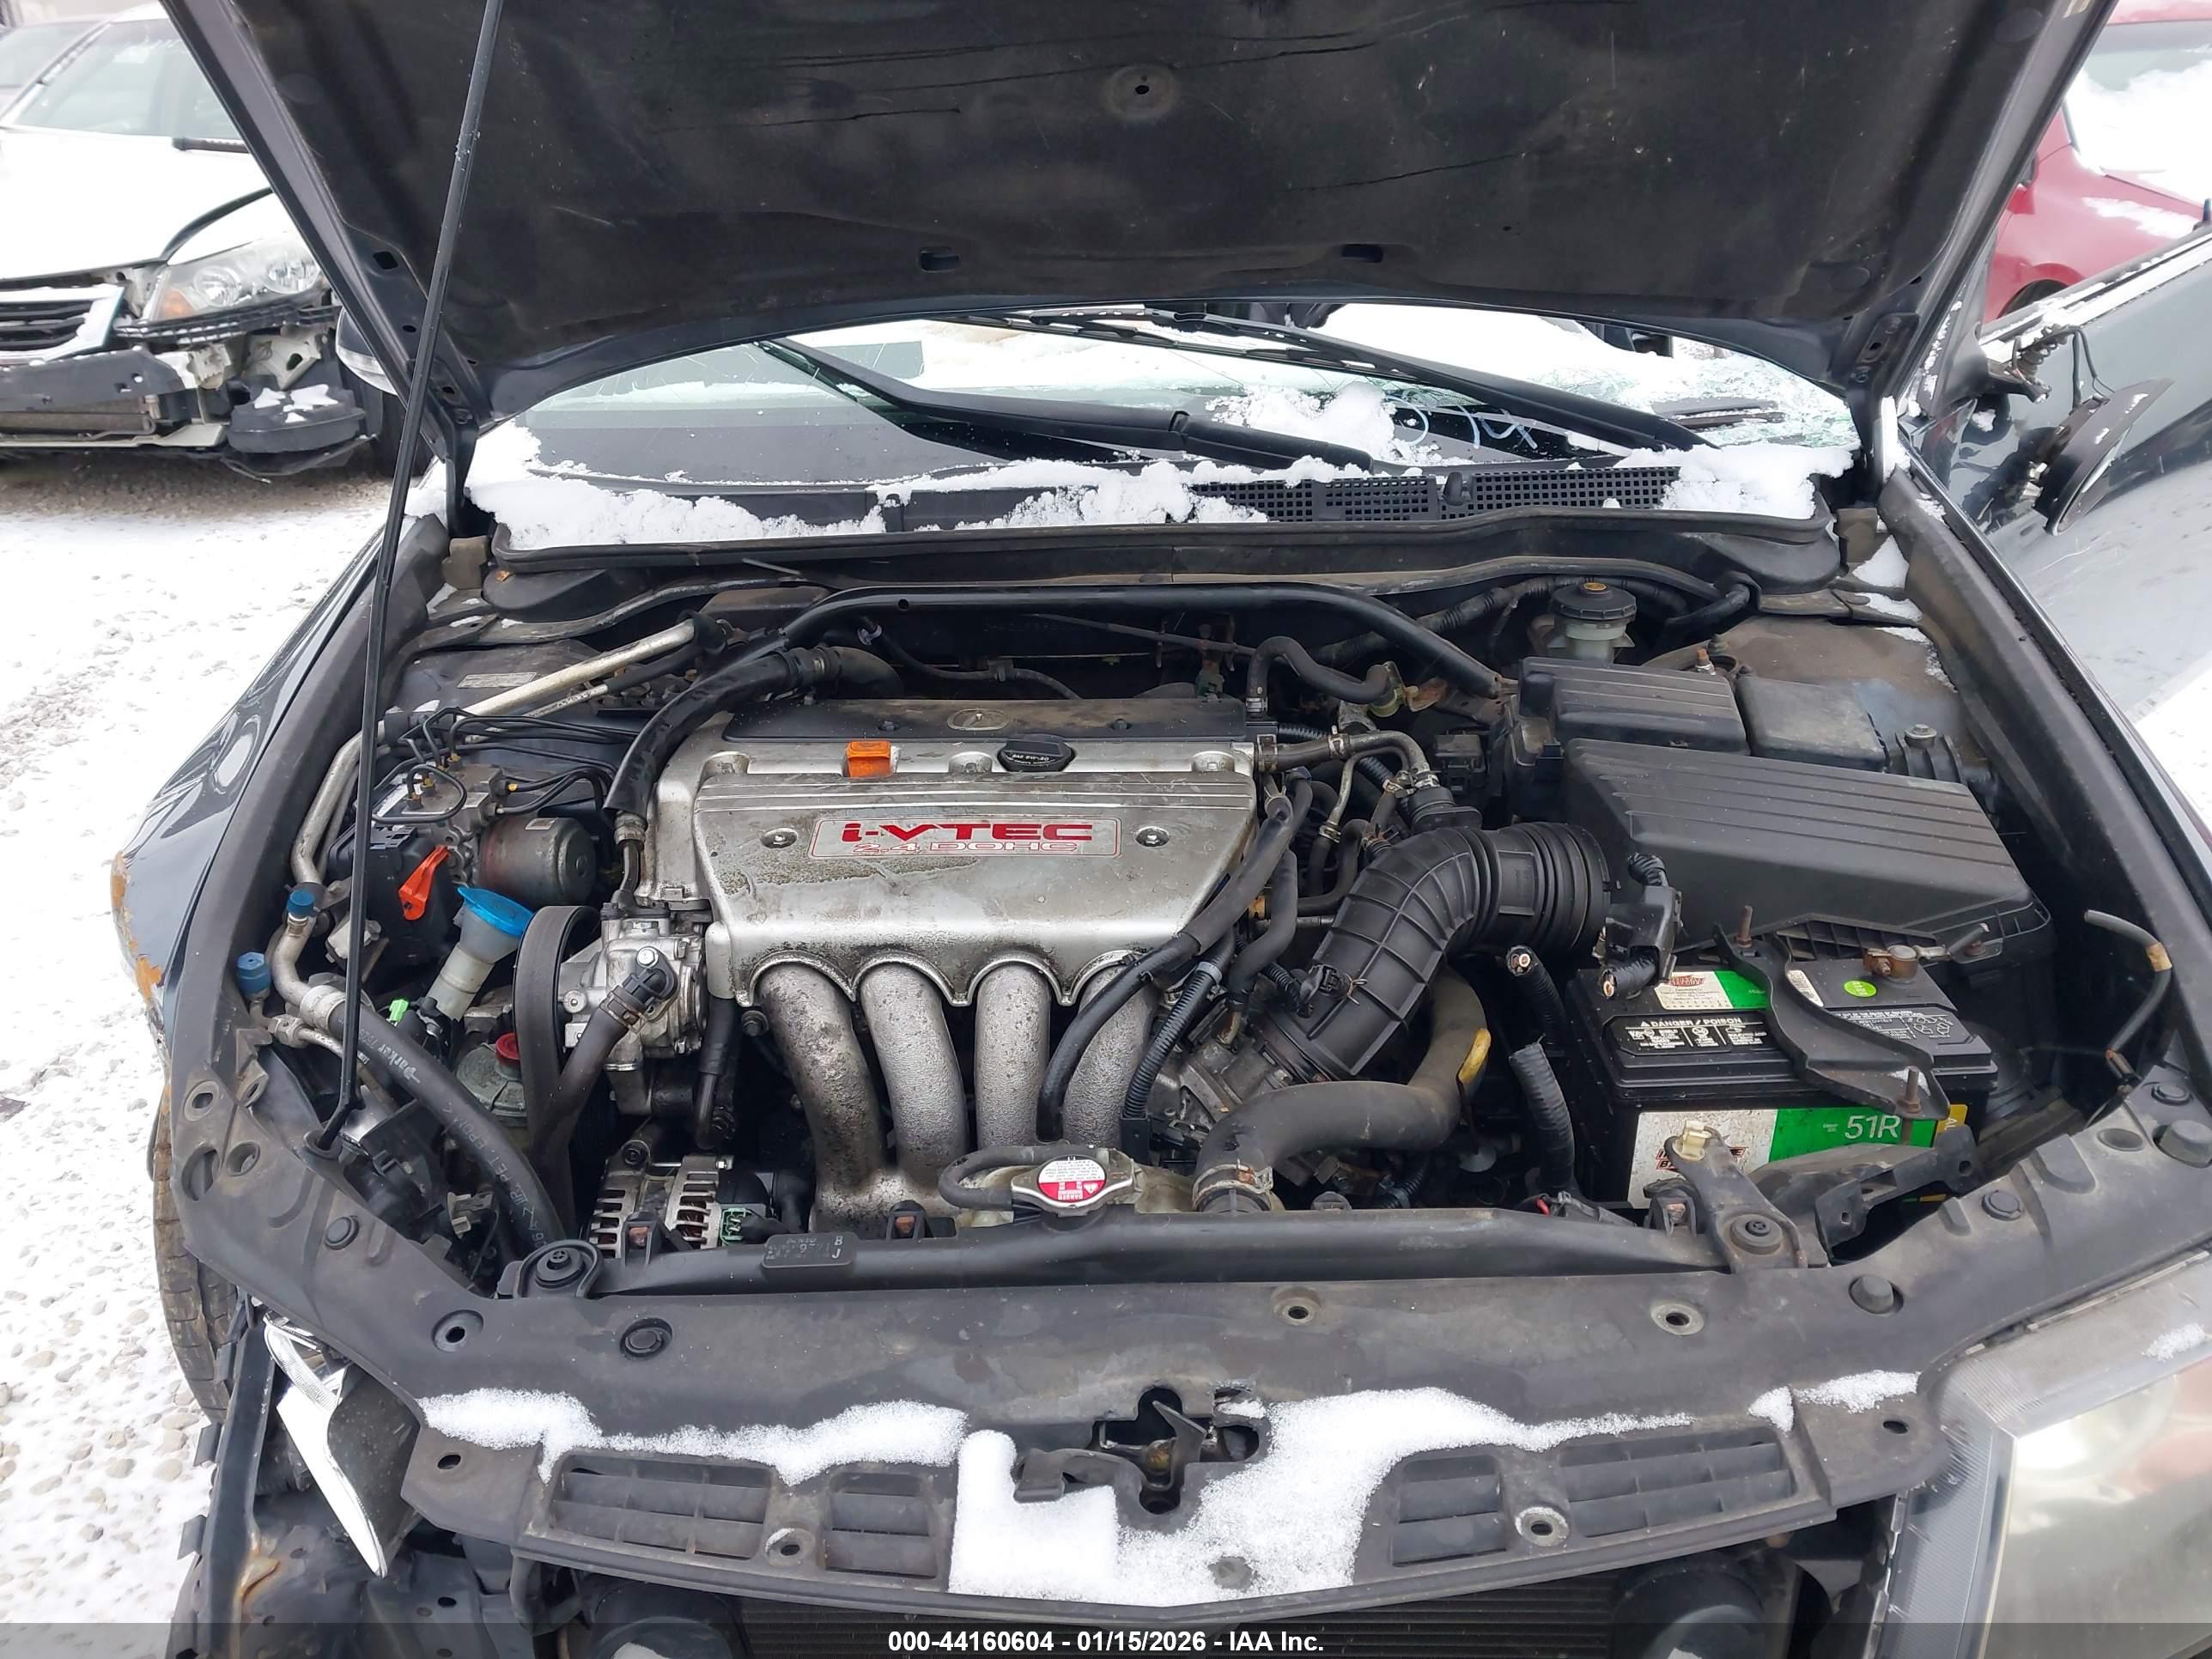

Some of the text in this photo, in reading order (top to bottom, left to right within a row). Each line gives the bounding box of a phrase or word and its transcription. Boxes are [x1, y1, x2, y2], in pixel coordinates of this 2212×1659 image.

[841, 823, 1092, 842] i-VTEC
[852, 841, 1078, 854] 2.4 DOHC
[1703, 1017, 1742, 1025] POISON
[1844, 1114, 1901, 1139] 51R
[834, 1236, 843, 1246] B
